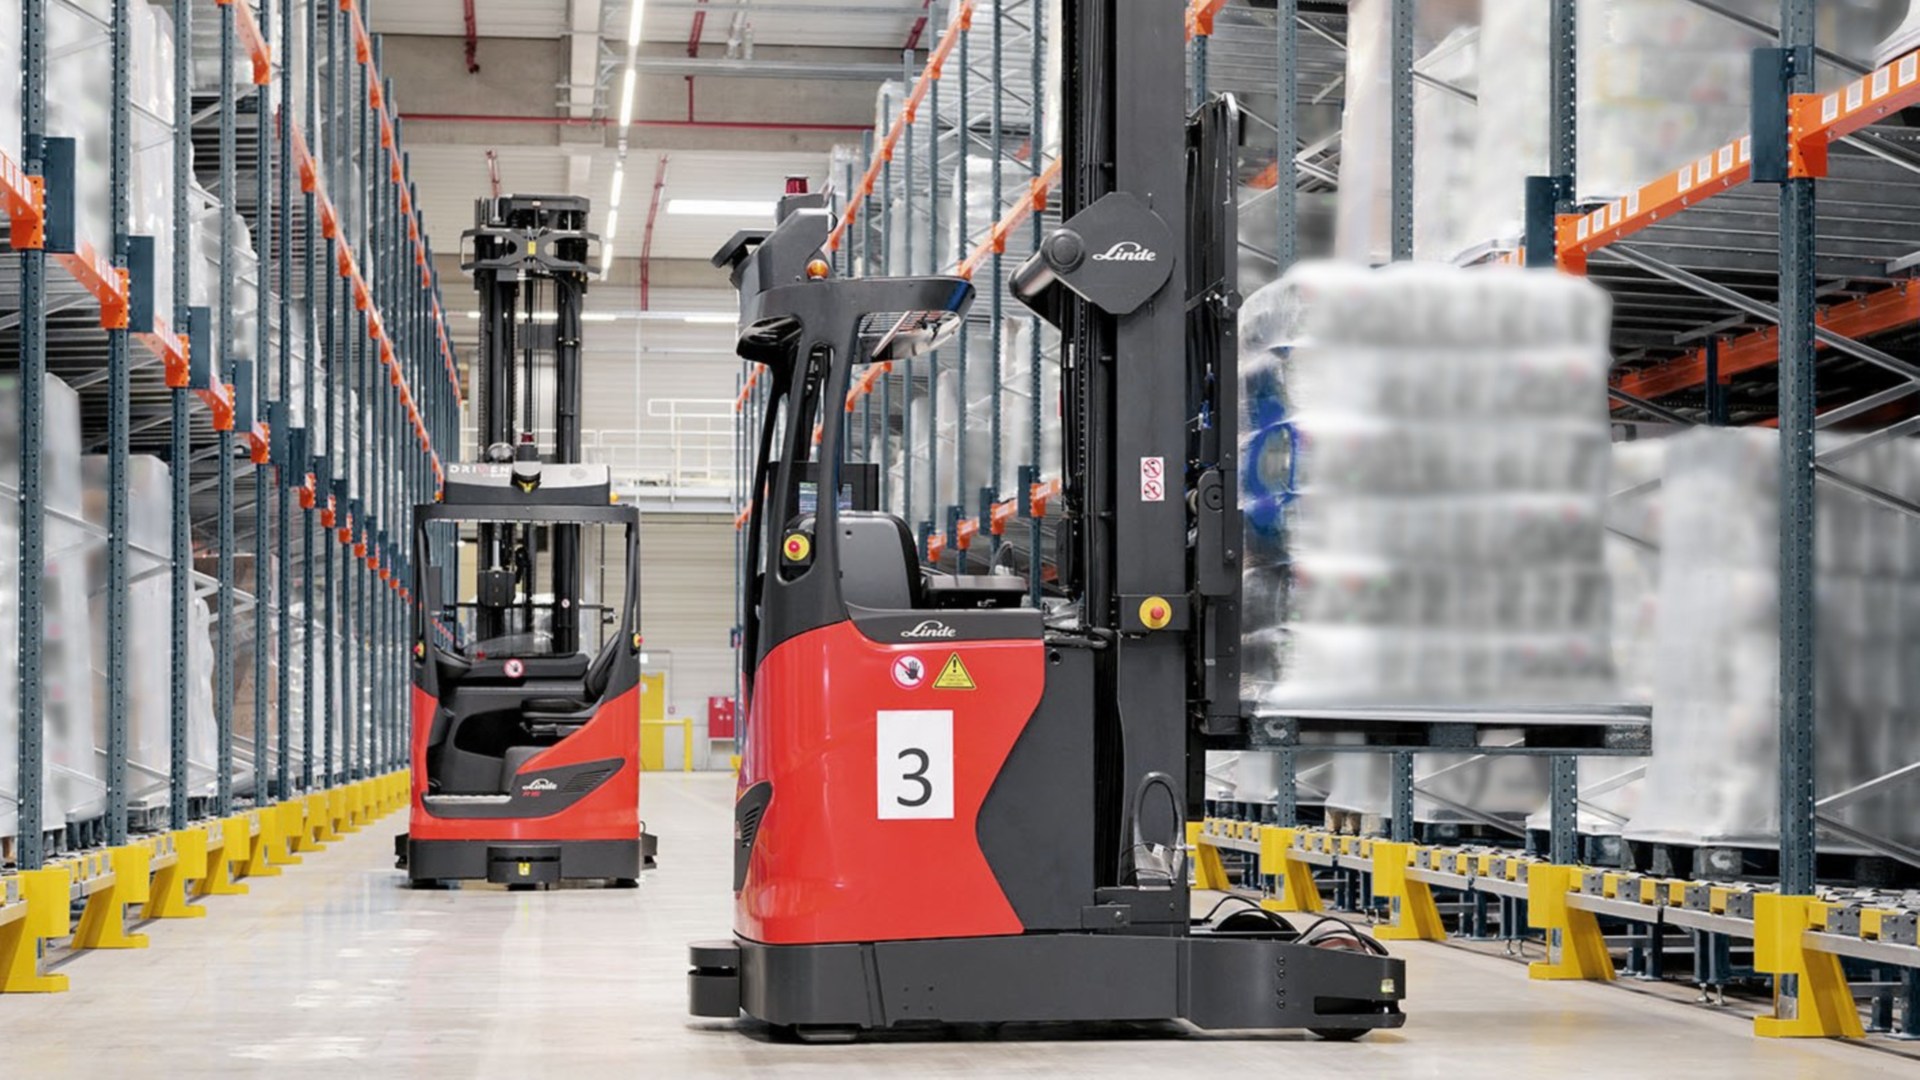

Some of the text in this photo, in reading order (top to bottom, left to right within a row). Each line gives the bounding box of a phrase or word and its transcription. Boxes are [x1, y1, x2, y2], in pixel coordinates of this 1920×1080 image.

[1092, 241, 1156, 261] Linde
[900, 619, 956, 638] Linde
[896, 747, 933, 807] 3
